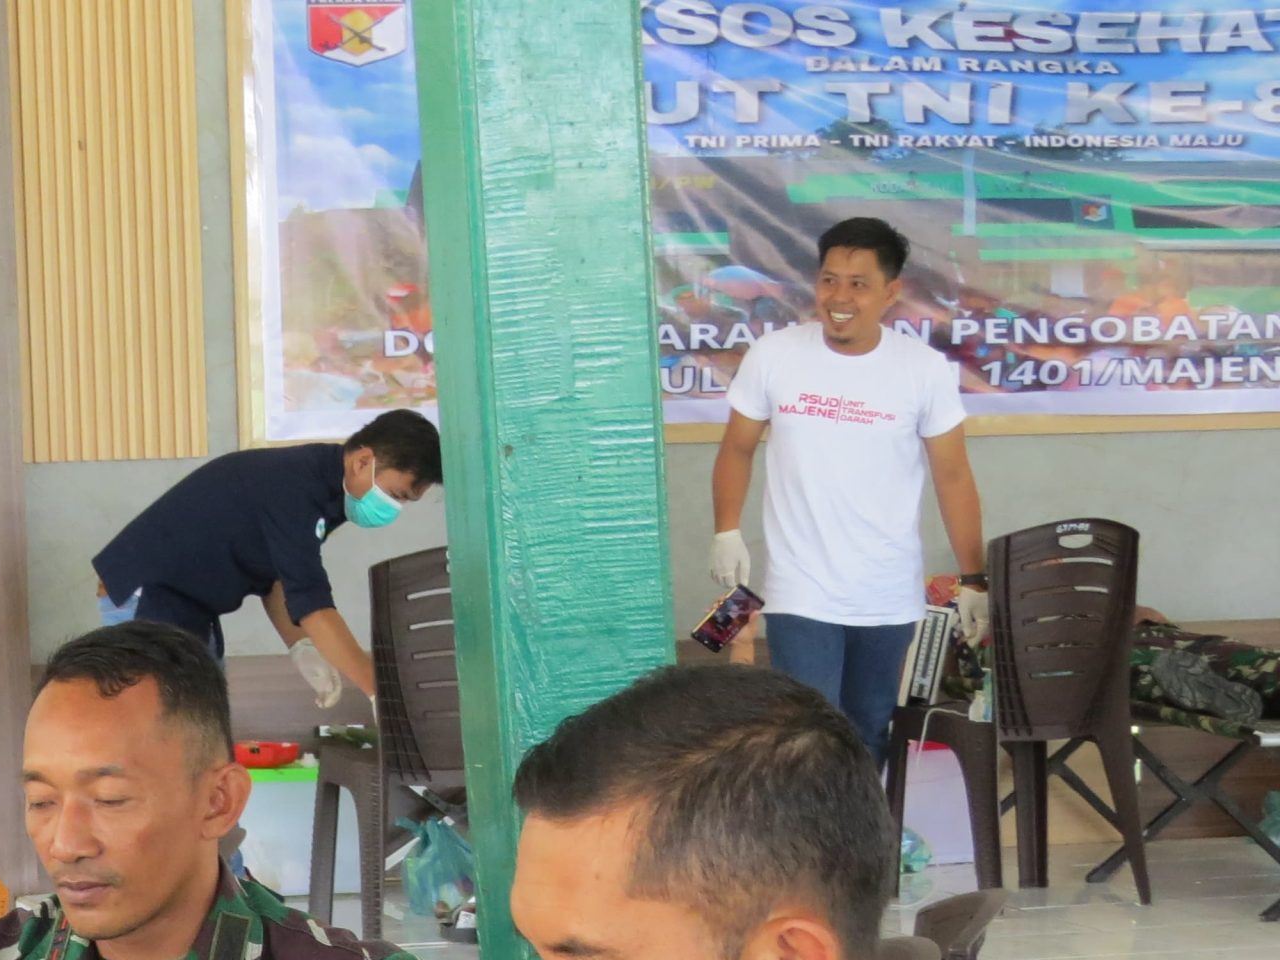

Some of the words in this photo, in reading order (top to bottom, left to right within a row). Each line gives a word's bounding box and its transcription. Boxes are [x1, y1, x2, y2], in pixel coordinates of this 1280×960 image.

[880, 8, 1280, 54] KESEHA
[806, 56, 942, 73] DALAM
[959, 58, 1119, 75] RANGKA
[826, 81, 1013, 125] TNI
[686, 134, 730, 148] TNI
[736, 134, 820, 148] PRIMA
[849, 134, 889, 148] TNI
[899, 134, 996, 149] RAKYAT
[1024, 134, 1160, 149] INDONESIA
[1169, 133, 1244, 148] MAJU
[658, 320, 797, 351] ARA
[798, 393, 839, 407] RSUD
[842, 398, 865, 408] UNIT
[778, 404, 837, 420] MAJENE
[840, 415, 874, 425] DARAH
[841, 407, 896, 422] TRANSFUSI
